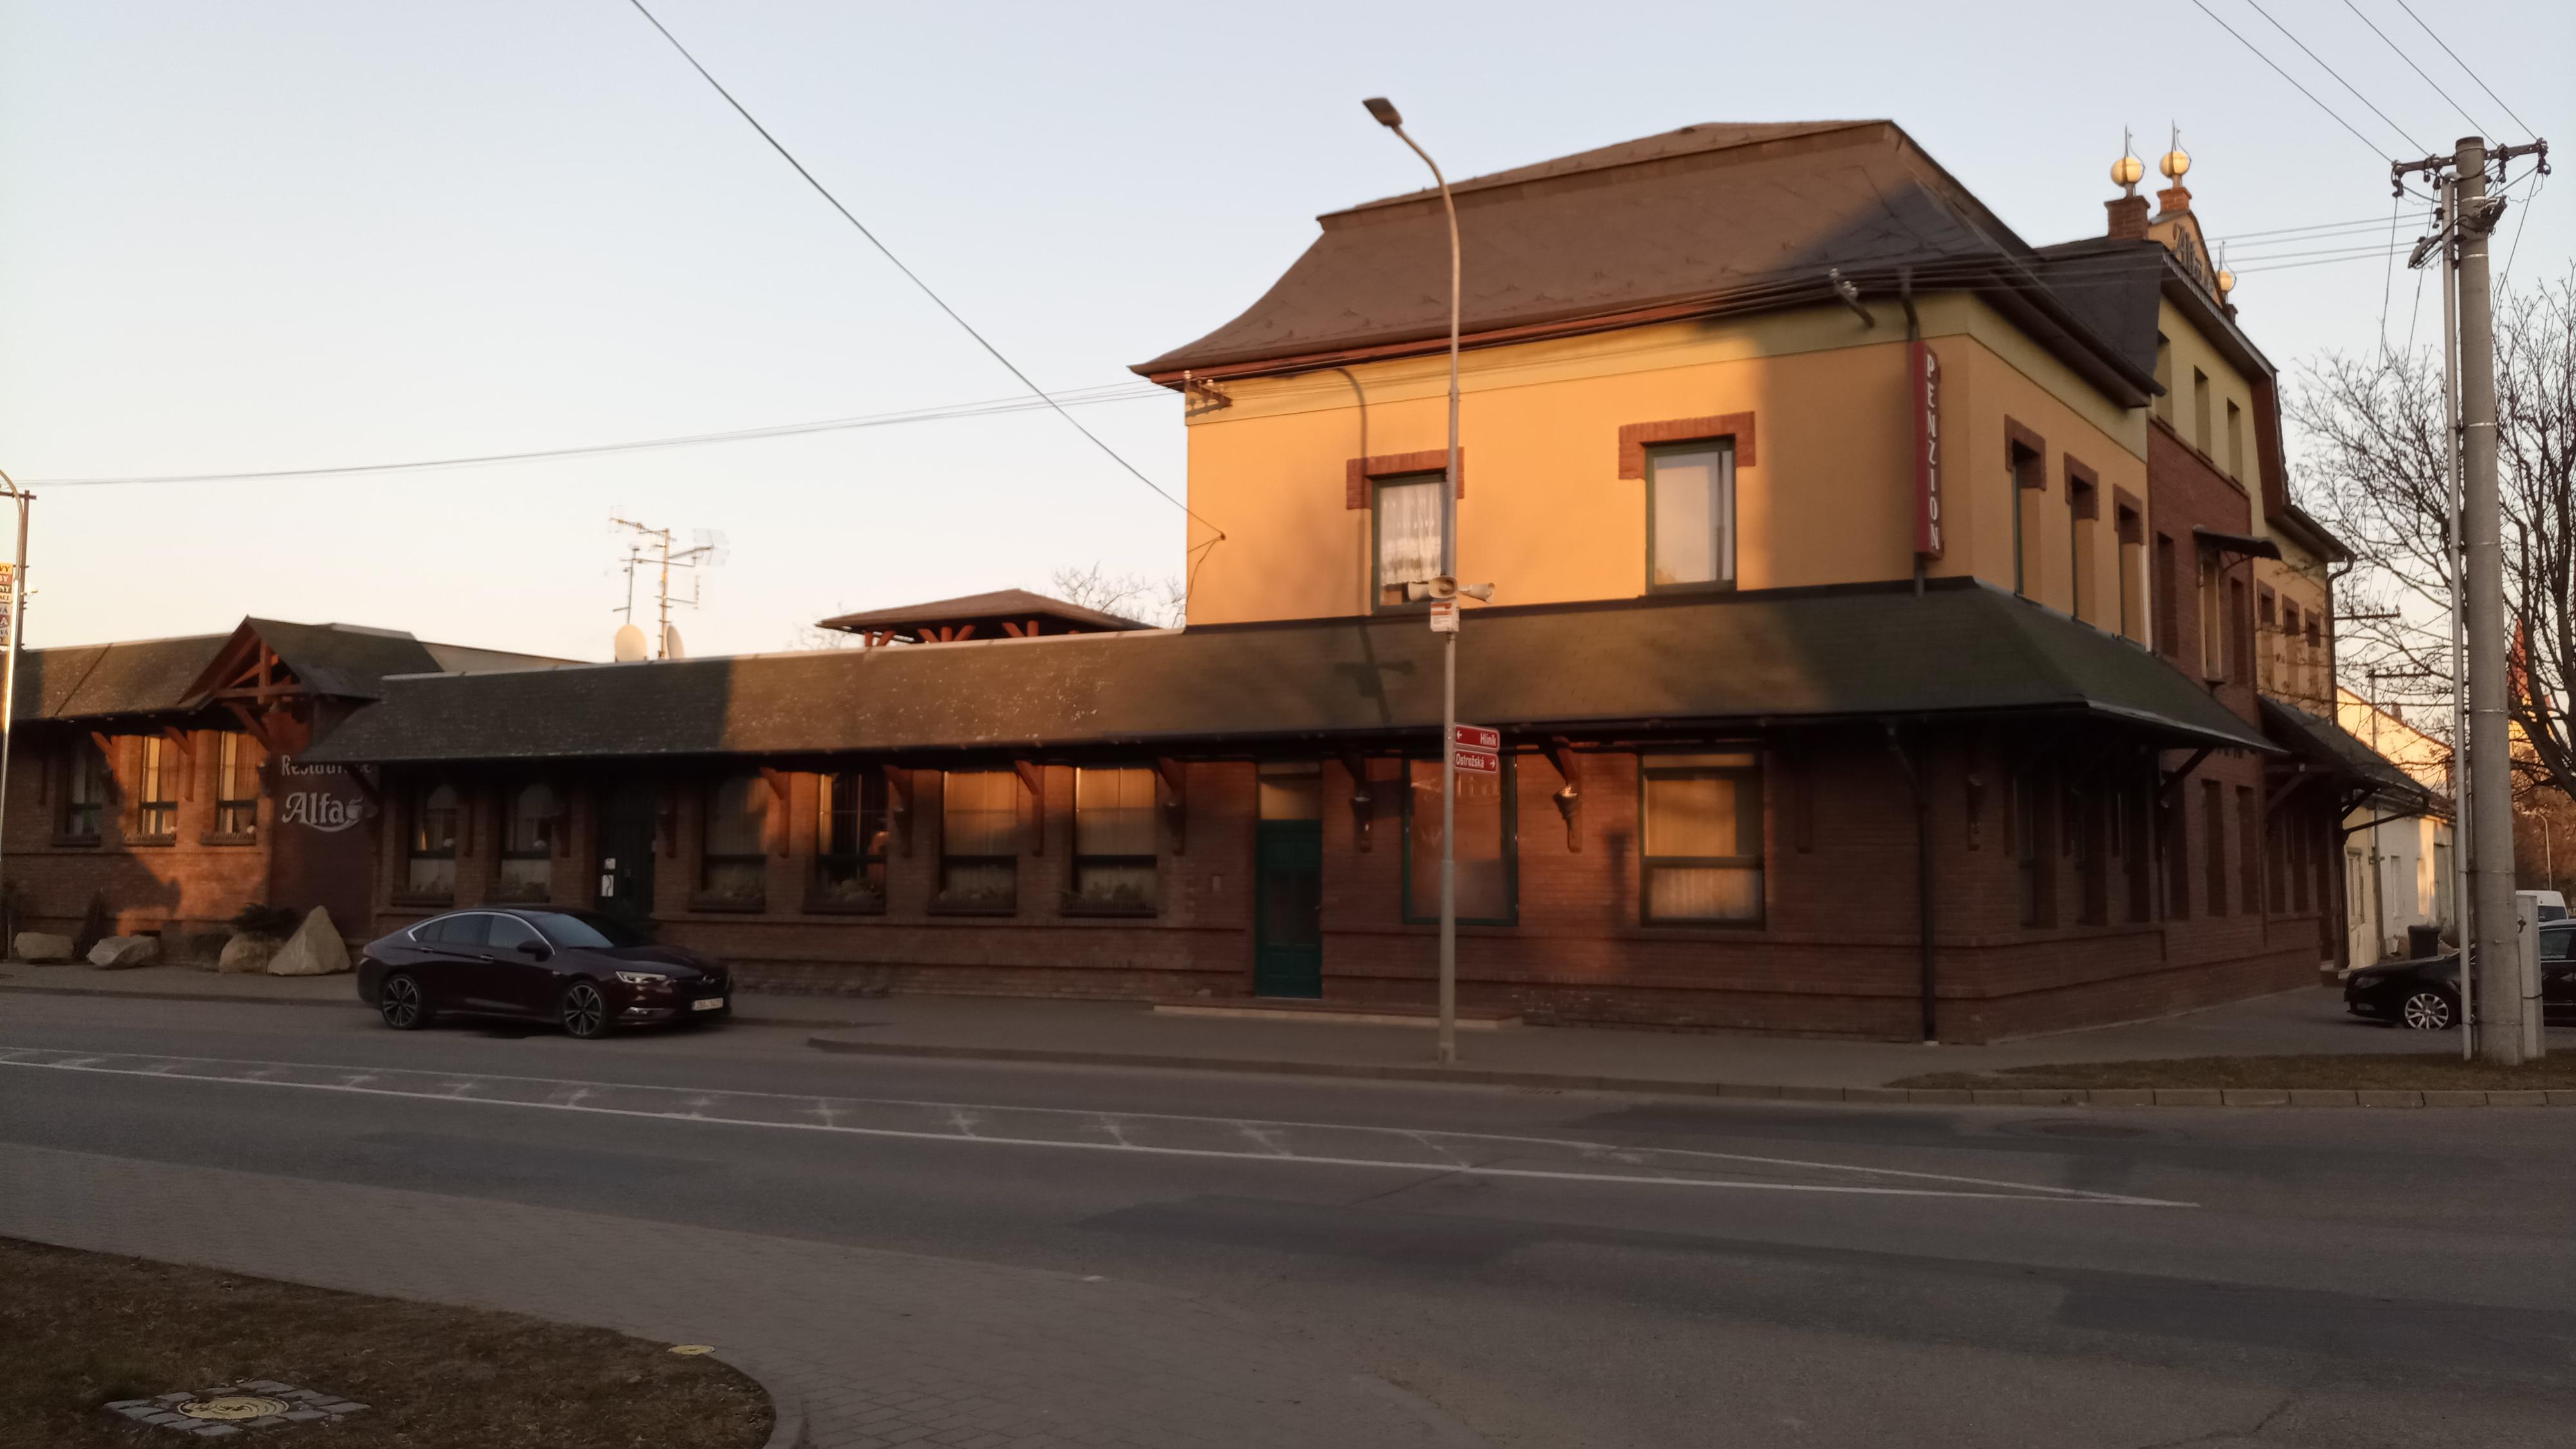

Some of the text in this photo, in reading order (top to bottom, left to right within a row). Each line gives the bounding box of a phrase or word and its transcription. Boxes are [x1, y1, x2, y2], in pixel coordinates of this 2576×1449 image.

[1926, 354, 1940, 551] PENZION
[1455, 753, 1484, 768] Ostrožská
[281, 791, 346, 824] Alfa
